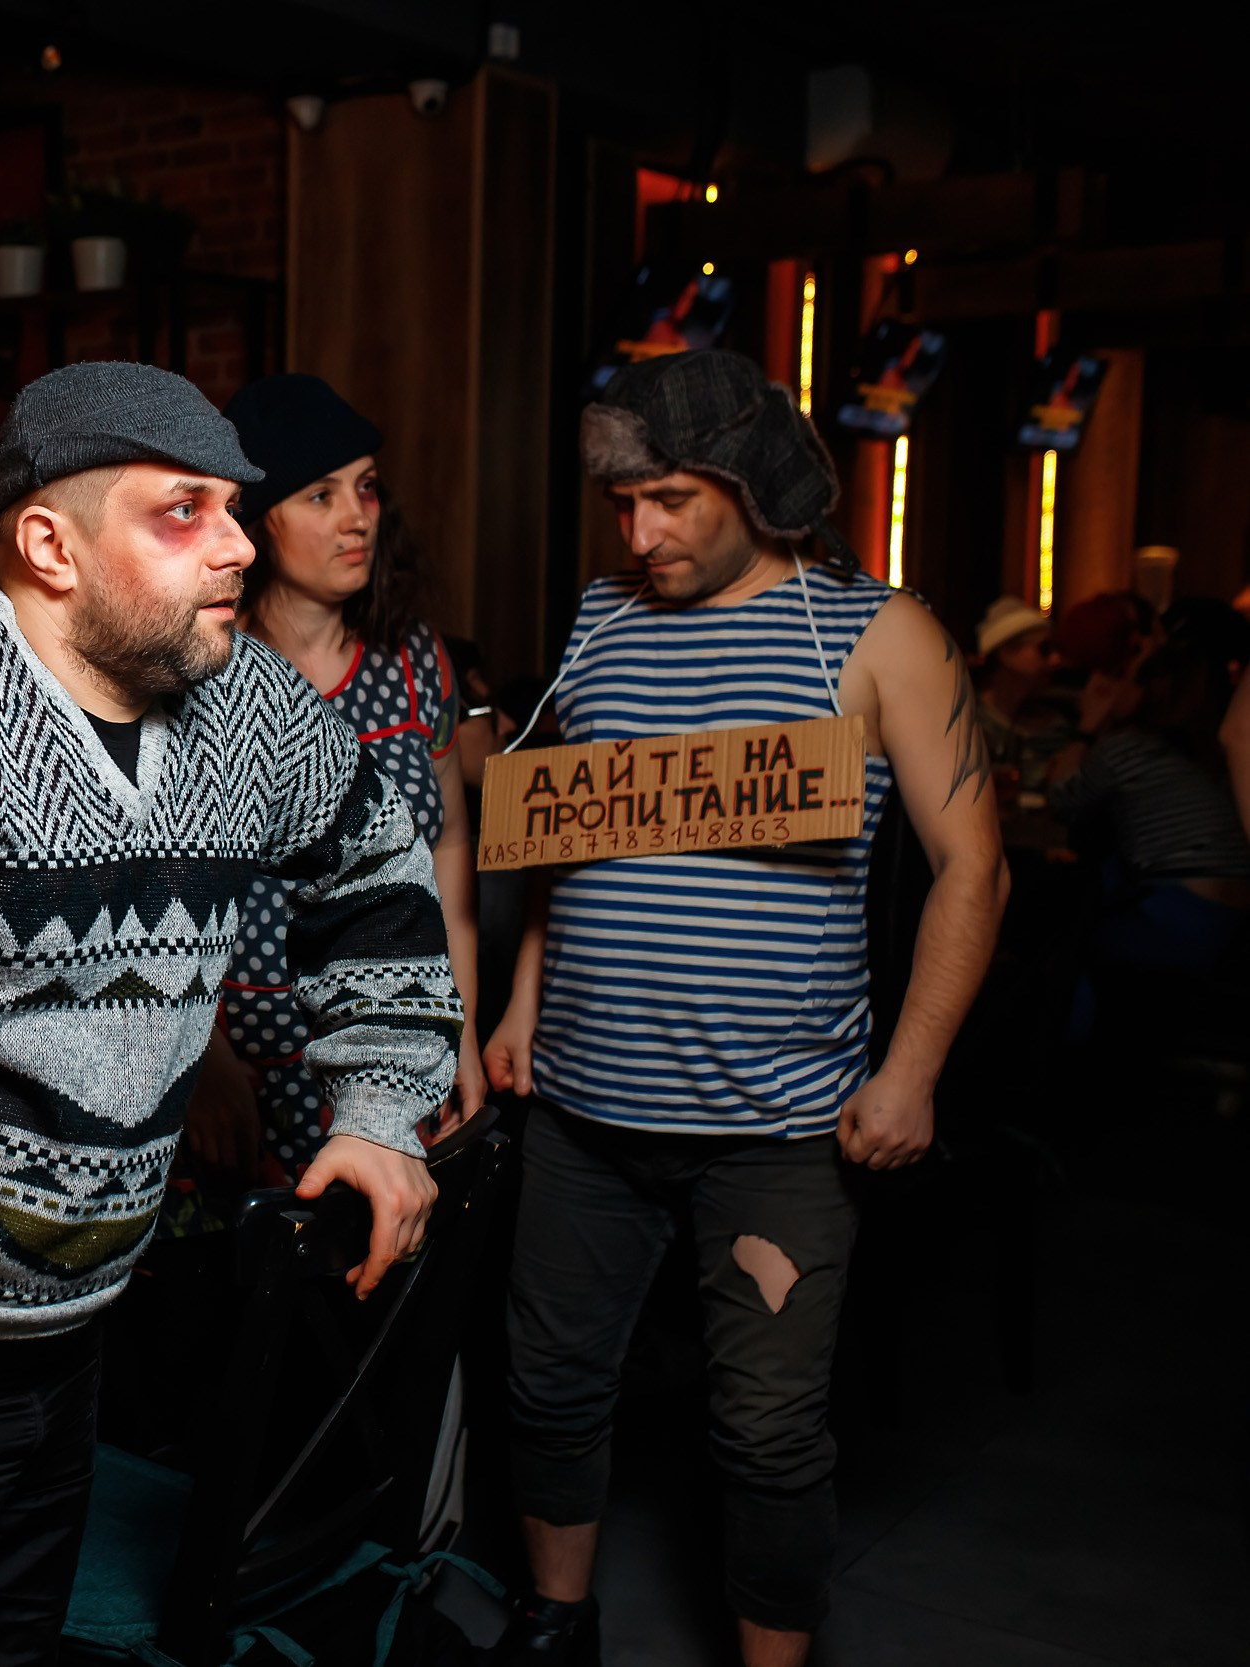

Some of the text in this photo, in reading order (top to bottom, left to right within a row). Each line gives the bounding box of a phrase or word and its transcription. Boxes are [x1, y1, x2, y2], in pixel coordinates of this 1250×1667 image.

[523, 733, 796, 803] ДАЙТЕ НА
[482, 816, 791, 866] KASPI 87783148863
